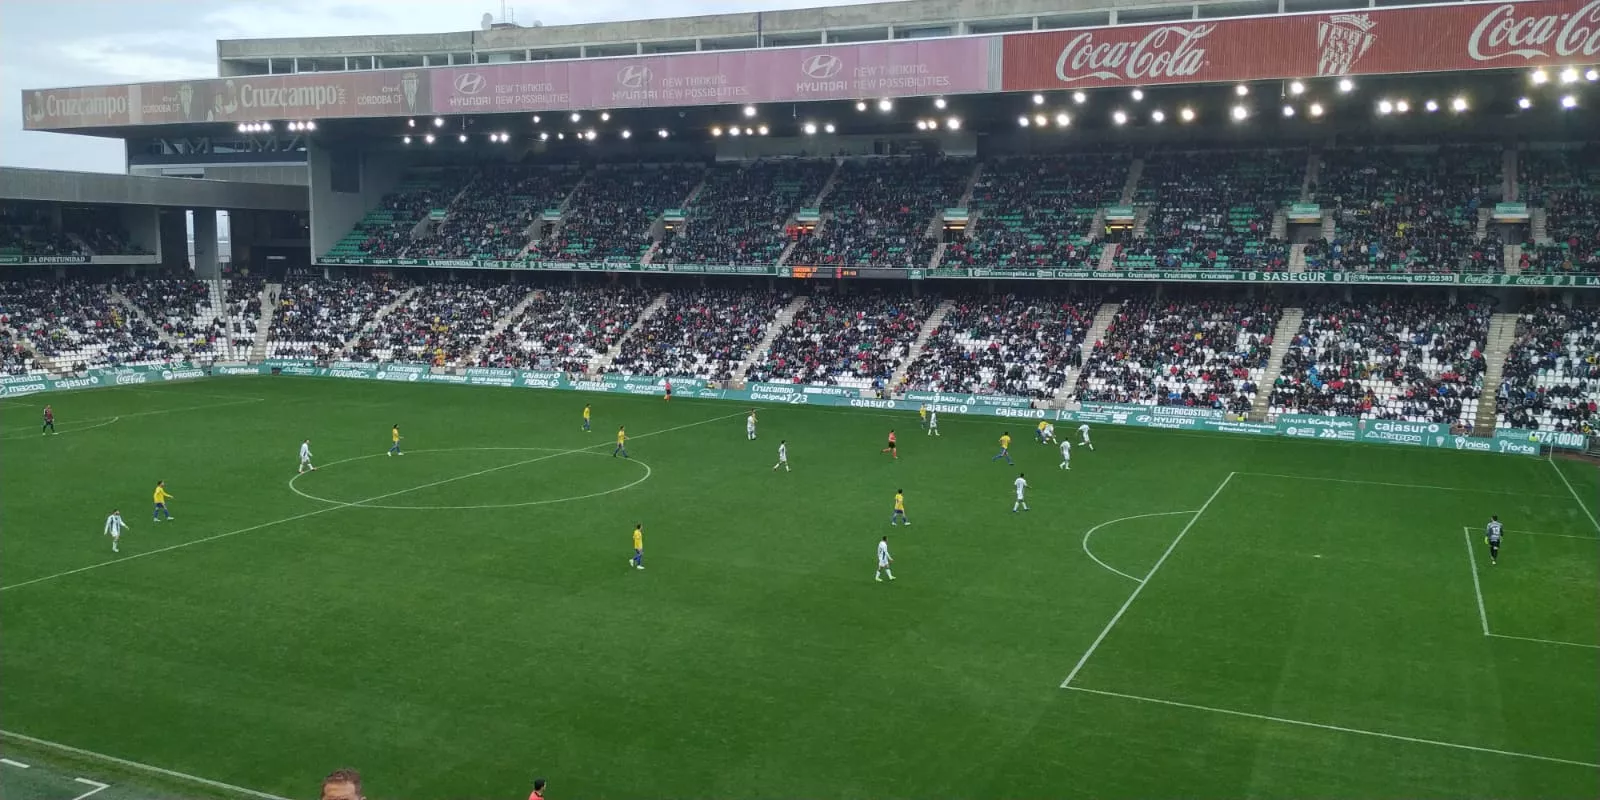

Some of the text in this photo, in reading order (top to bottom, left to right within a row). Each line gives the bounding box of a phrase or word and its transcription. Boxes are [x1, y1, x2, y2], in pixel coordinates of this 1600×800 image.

[796, 80, 848, 92] HYUNDAI
[240, 84, 338, 110] Cruzcampo
[612, 90, 658, 101] HYUNDAI
[46, 94, 127, 120] Cruzcampo
[449, 96, 491, 107] HYUNDAI
[1262, 271, 1326, 282] SASEGUR
[522, 372, 552, 381] cajasur
[55, 377, 90, 389] cajasur
[850, 398, 887, 409] cajasur
[995, 408, 1034, 419] cajasur
[1153, 416, 1195, 425] HYUNDAI
[1374, 421, 1426, 433] cajasur
